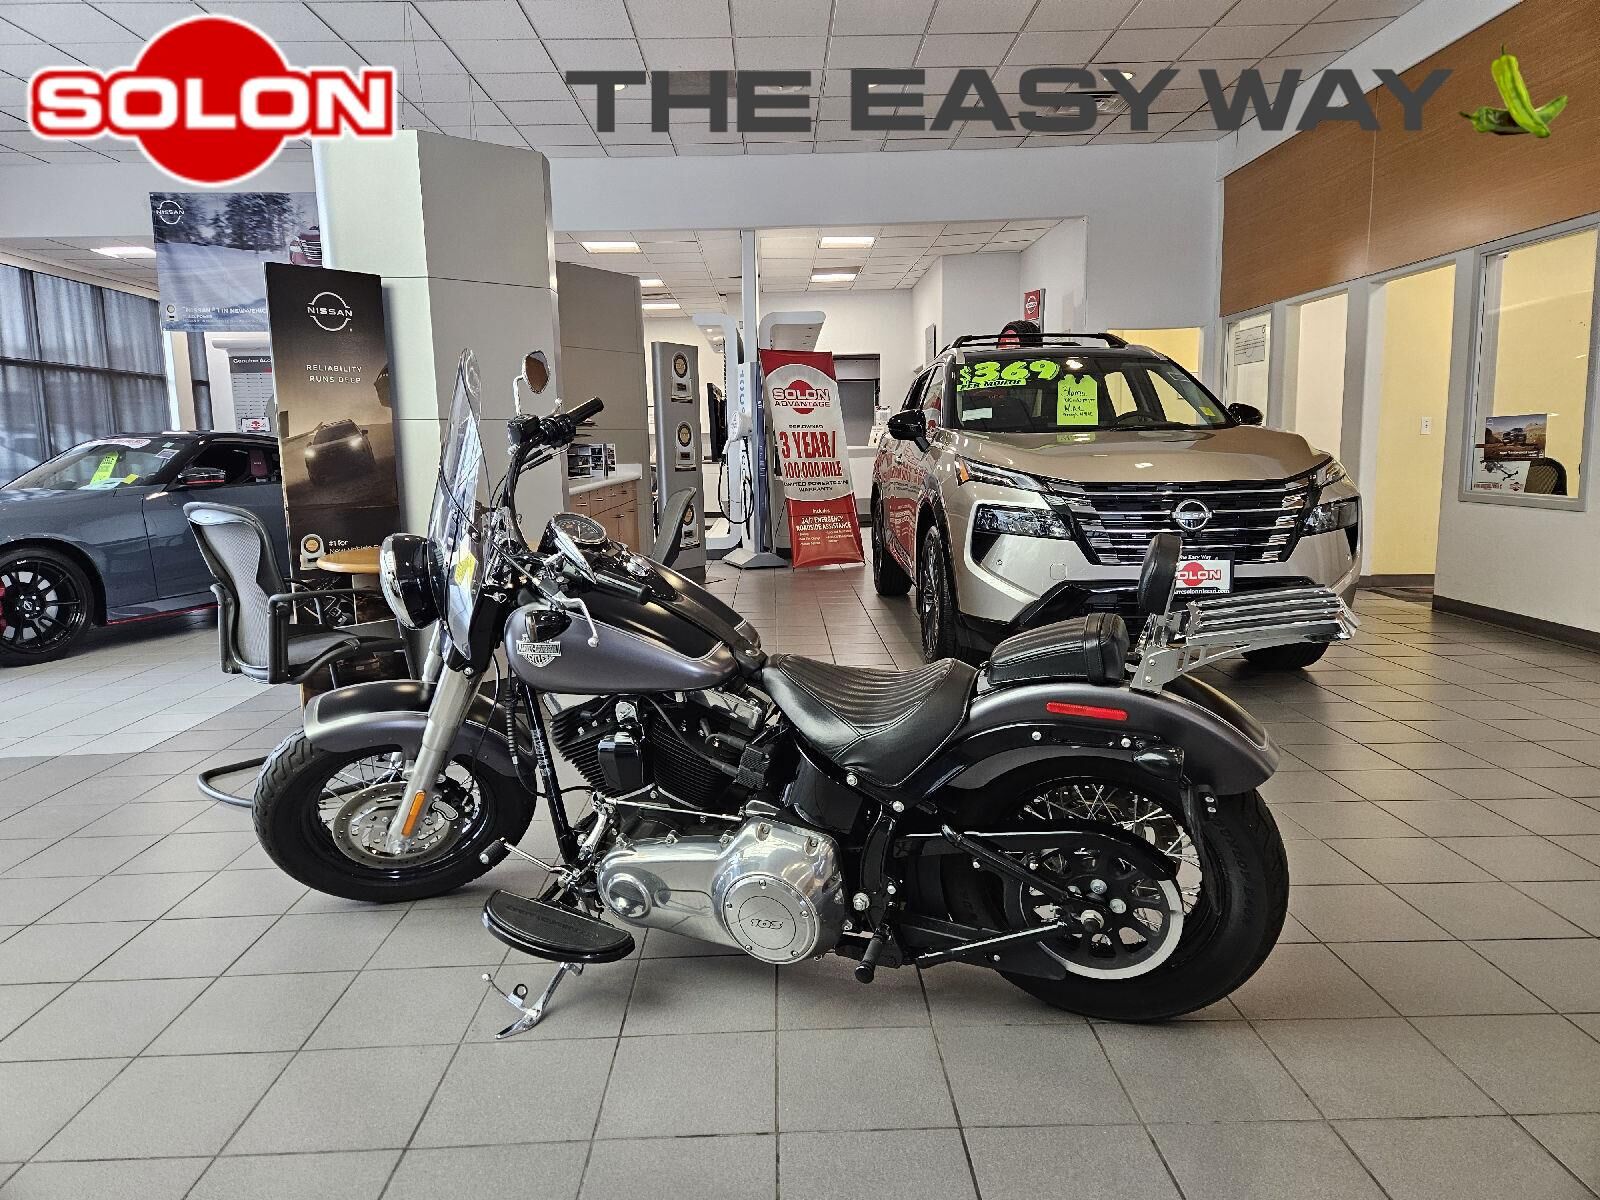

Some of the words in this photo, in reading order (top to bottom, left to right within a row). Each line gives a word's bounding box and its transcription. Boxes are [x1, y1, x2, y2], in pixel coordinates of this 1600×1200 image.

[307, 306, 353, 317] NISSAN
[306, 364, 362, 373] RELIABILITY
[959, 360, 1060, 386] $369
[309, 375, 335, 383] RUNS
[338, 376, 361, 384] DEEP
[772, 387, 831, 401] SOLON
[779, 431, 791, 459] 3
[791, 430, 837, 459] YEAR/
[783, 461, 820, 480] 100,000
[820, 460, 843, 477] MILE
[796, 523, 823, 532] ROADSIDE
[823, 521, 852, 530] ASSISTANCE
[338, 539, 349, 547] for
[1176, 569, 1222, 581] OLON
